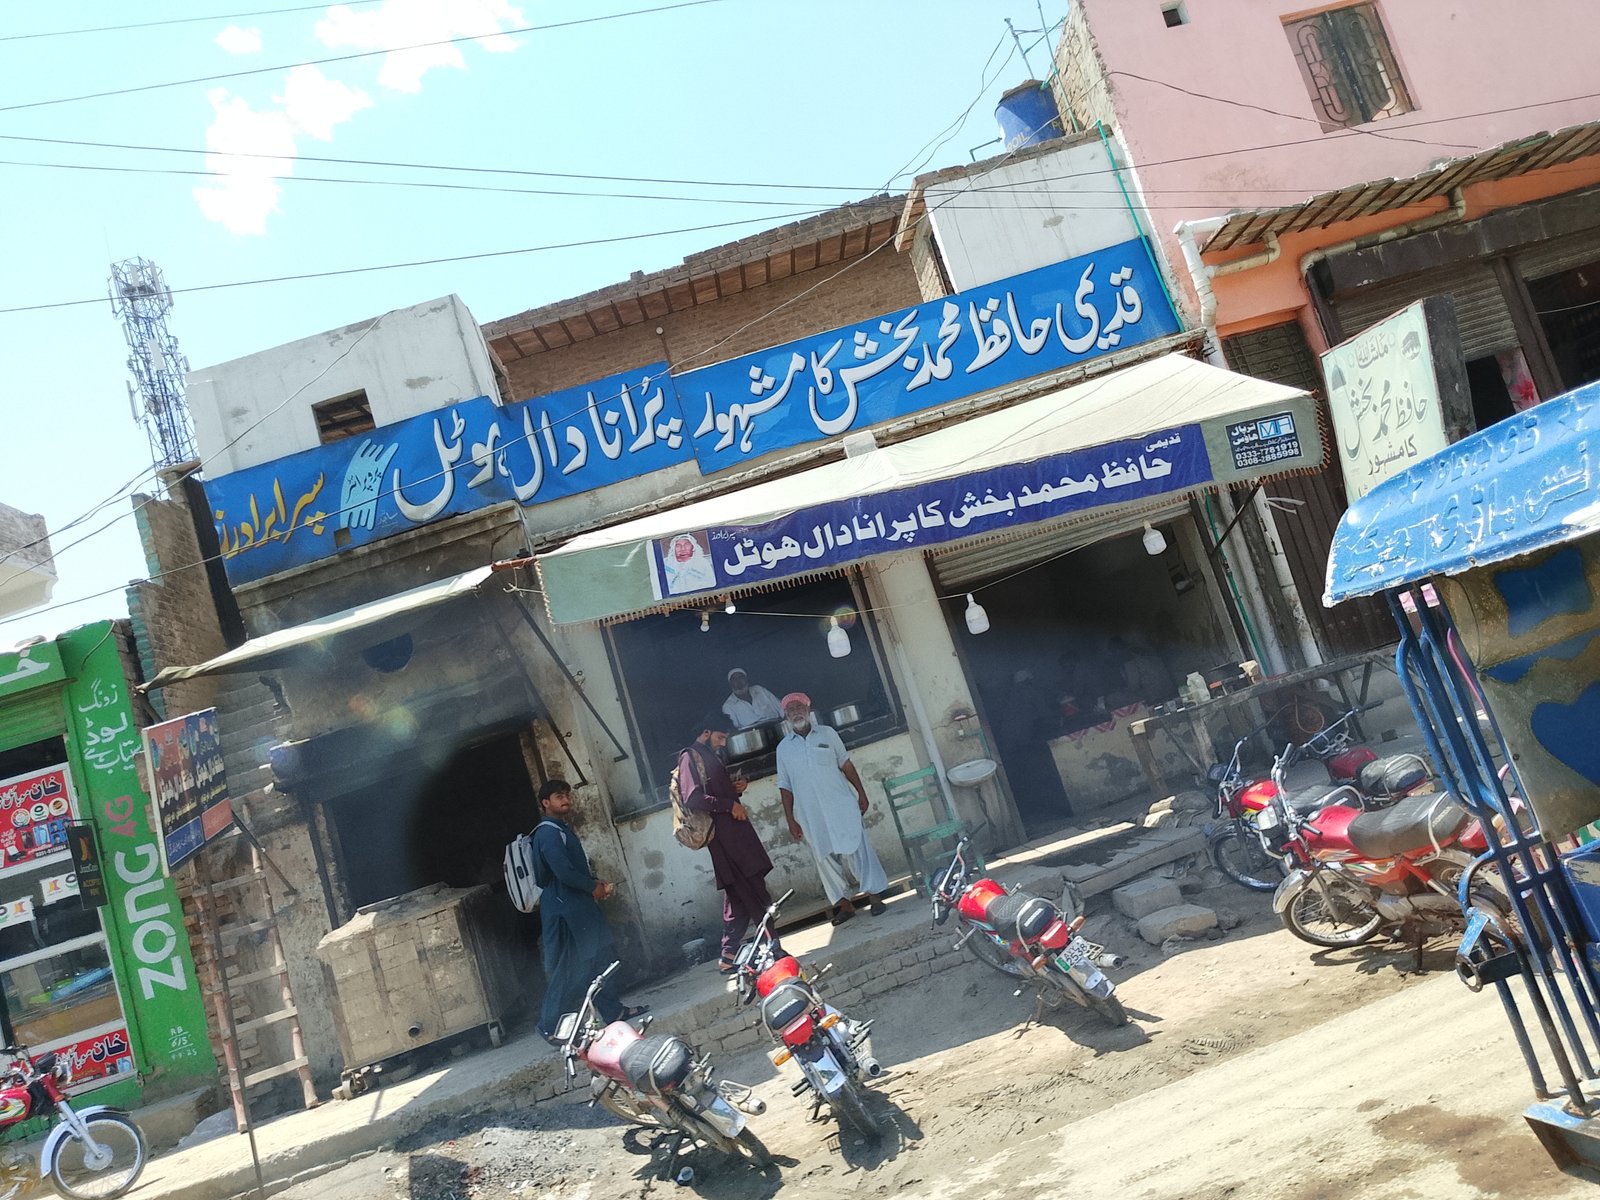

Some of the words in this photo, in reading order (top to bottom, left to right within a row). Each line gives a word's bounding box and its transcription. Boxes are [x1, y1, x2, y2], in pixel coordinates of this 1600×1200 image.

[966, 292, 1052, 373] حافظ
[1056, 262, 1143, 353] قدیمی
[809, 309, 919, 436] بخش
[811, 338, 843, 394] کا
[905, 301, 961, 392] محمد
[694, 352, 806, 453] مشہور
[1372, 379, 1392, 442] محمد
[1396, 381, 1429, 430] حافظ
[392, 408, 511, 522] ہوٹل
[511, 406, 588, 501] دال
[1101, 454, 1172, 489] حافظ
[949, 488, 1016, 528] بخش
[1017, 473, 1099, 507] محمد
[804, 522, 853, 559] دال
[851, 511, 919, 544] پرانا
[85, 711, 129, 745] لوڈ
[30, 776, 62, 801] خان
[92, 1034, 128, 1062] خان
